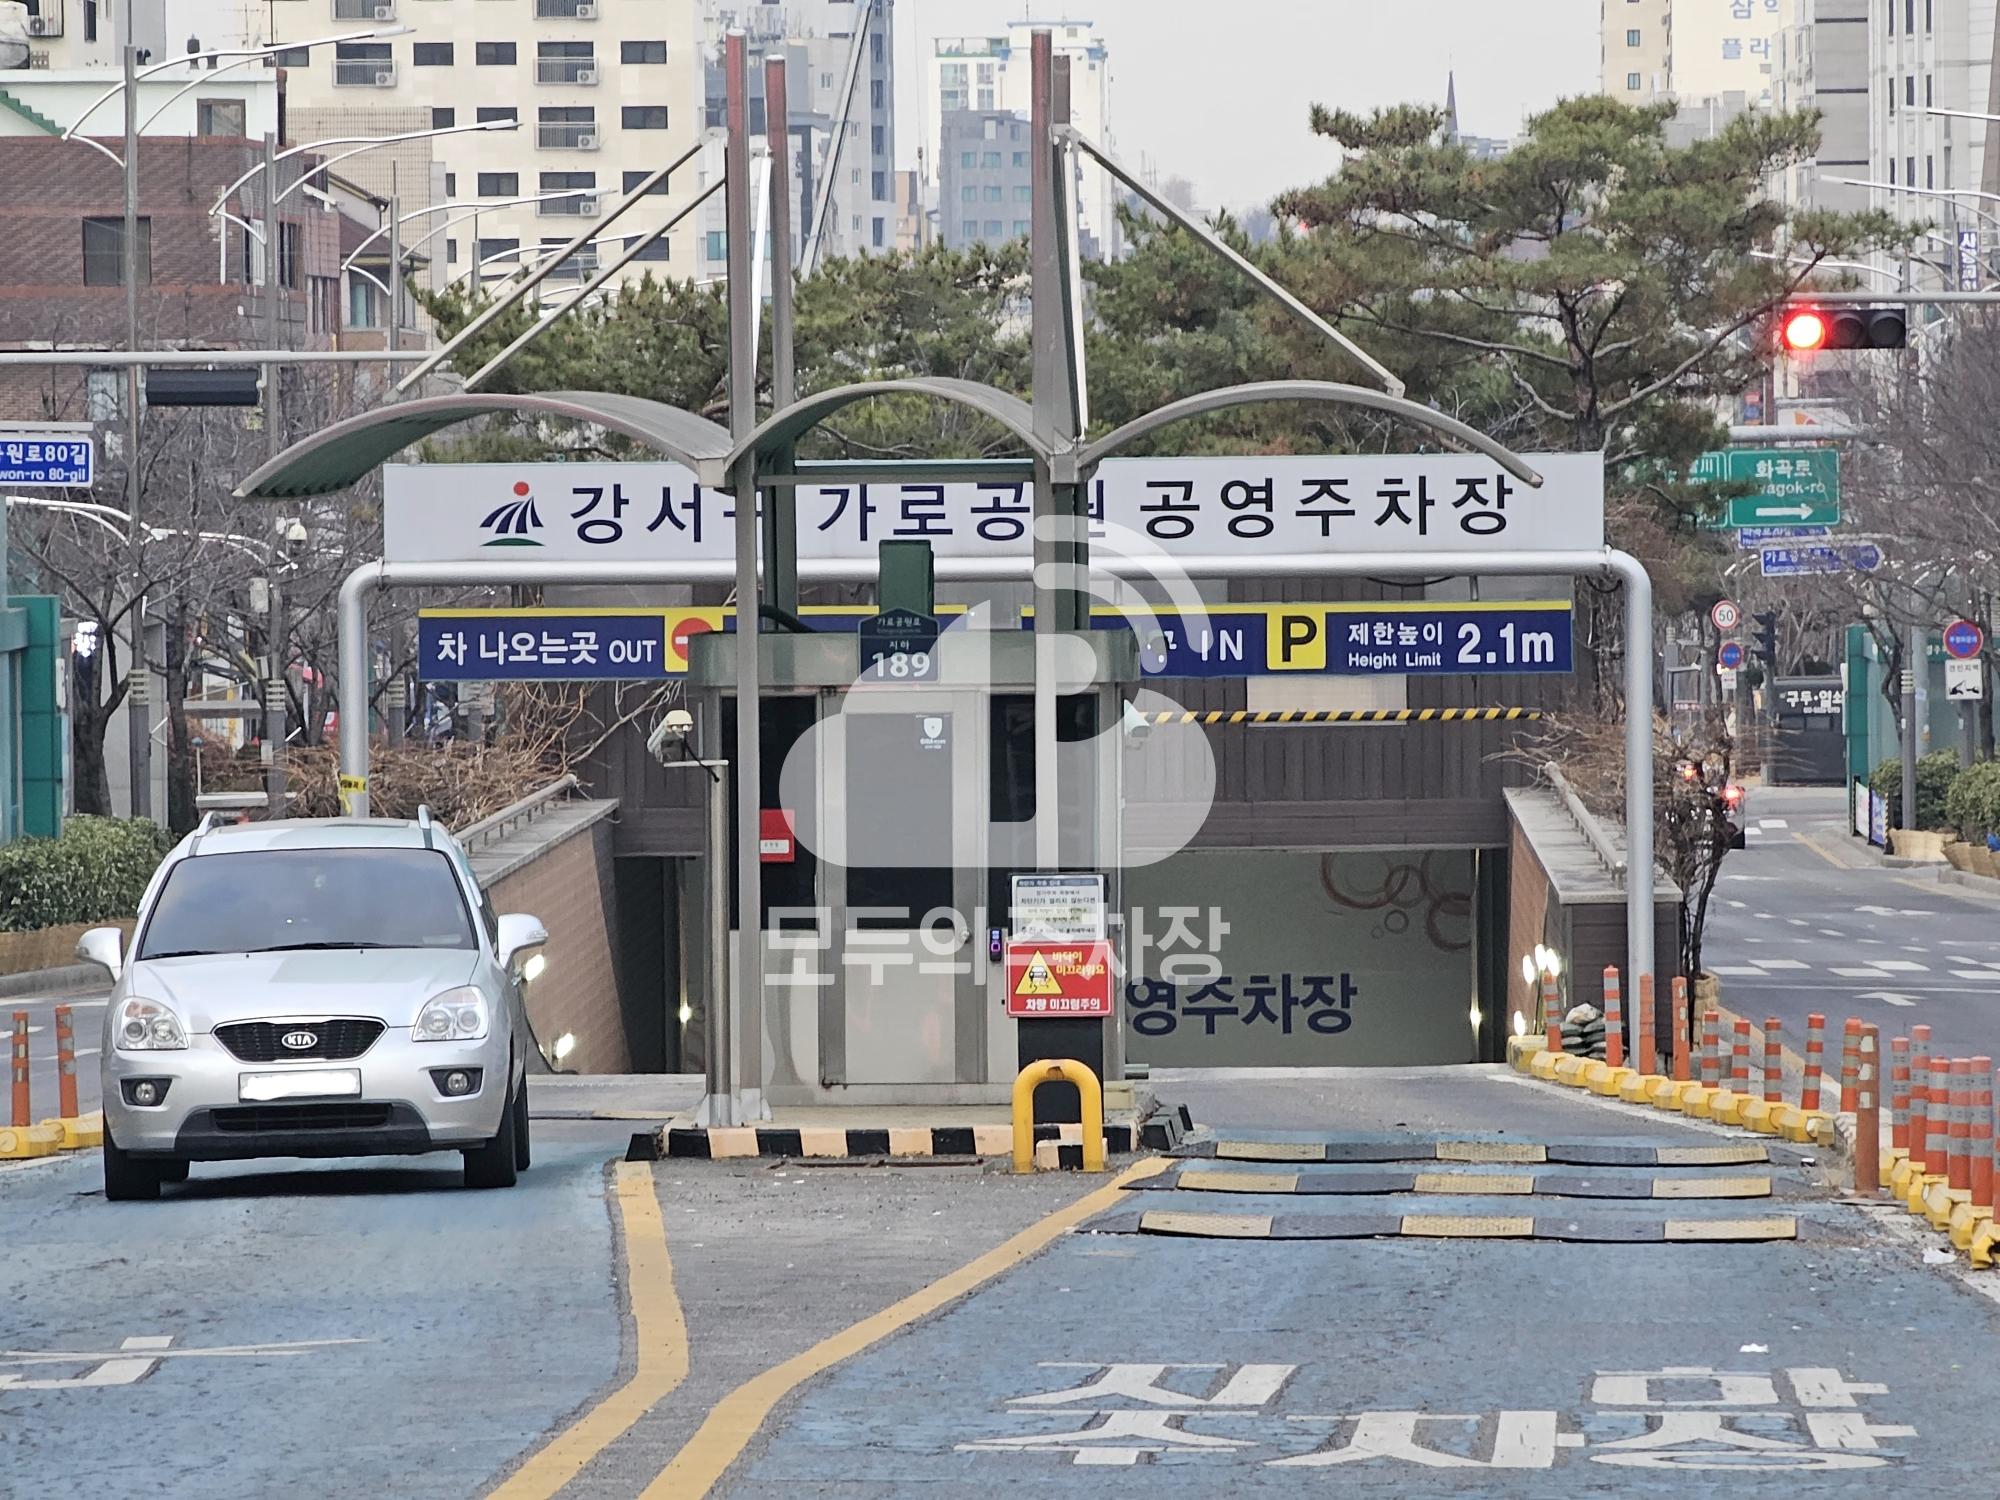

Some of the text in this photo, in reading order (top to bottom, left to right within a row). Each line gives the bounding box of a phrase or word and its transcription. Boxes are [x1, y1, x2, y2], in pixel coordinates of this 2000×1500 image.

[48, 467, 86, 483] 80-gil
[1755, 459, 1813, 478] 화곡로
[1140, 473, 1514, 540] 공영주차장
[1719, 610, 1734, 622] 50
[888, 639, 910, 651] 지하
[1201, 629, 1243, 662] IN
[1282, 615, 1318, 663] P
[1348, 621, 1443, 646] 제한높이
[1457, 622, 1555, 664] 2.1m
[437, 631, 657, 666] 차 나오는곳 OUT
[1348, 652, 1442, 670] Height Limit
[872, 651, 931, 678] 189
[1025, 998, 1101, 1011] 차량 미끄럼주의
[1125, 973, 1358, 1036] 영주차장
[287, 1034, 312, 1046] KIA
